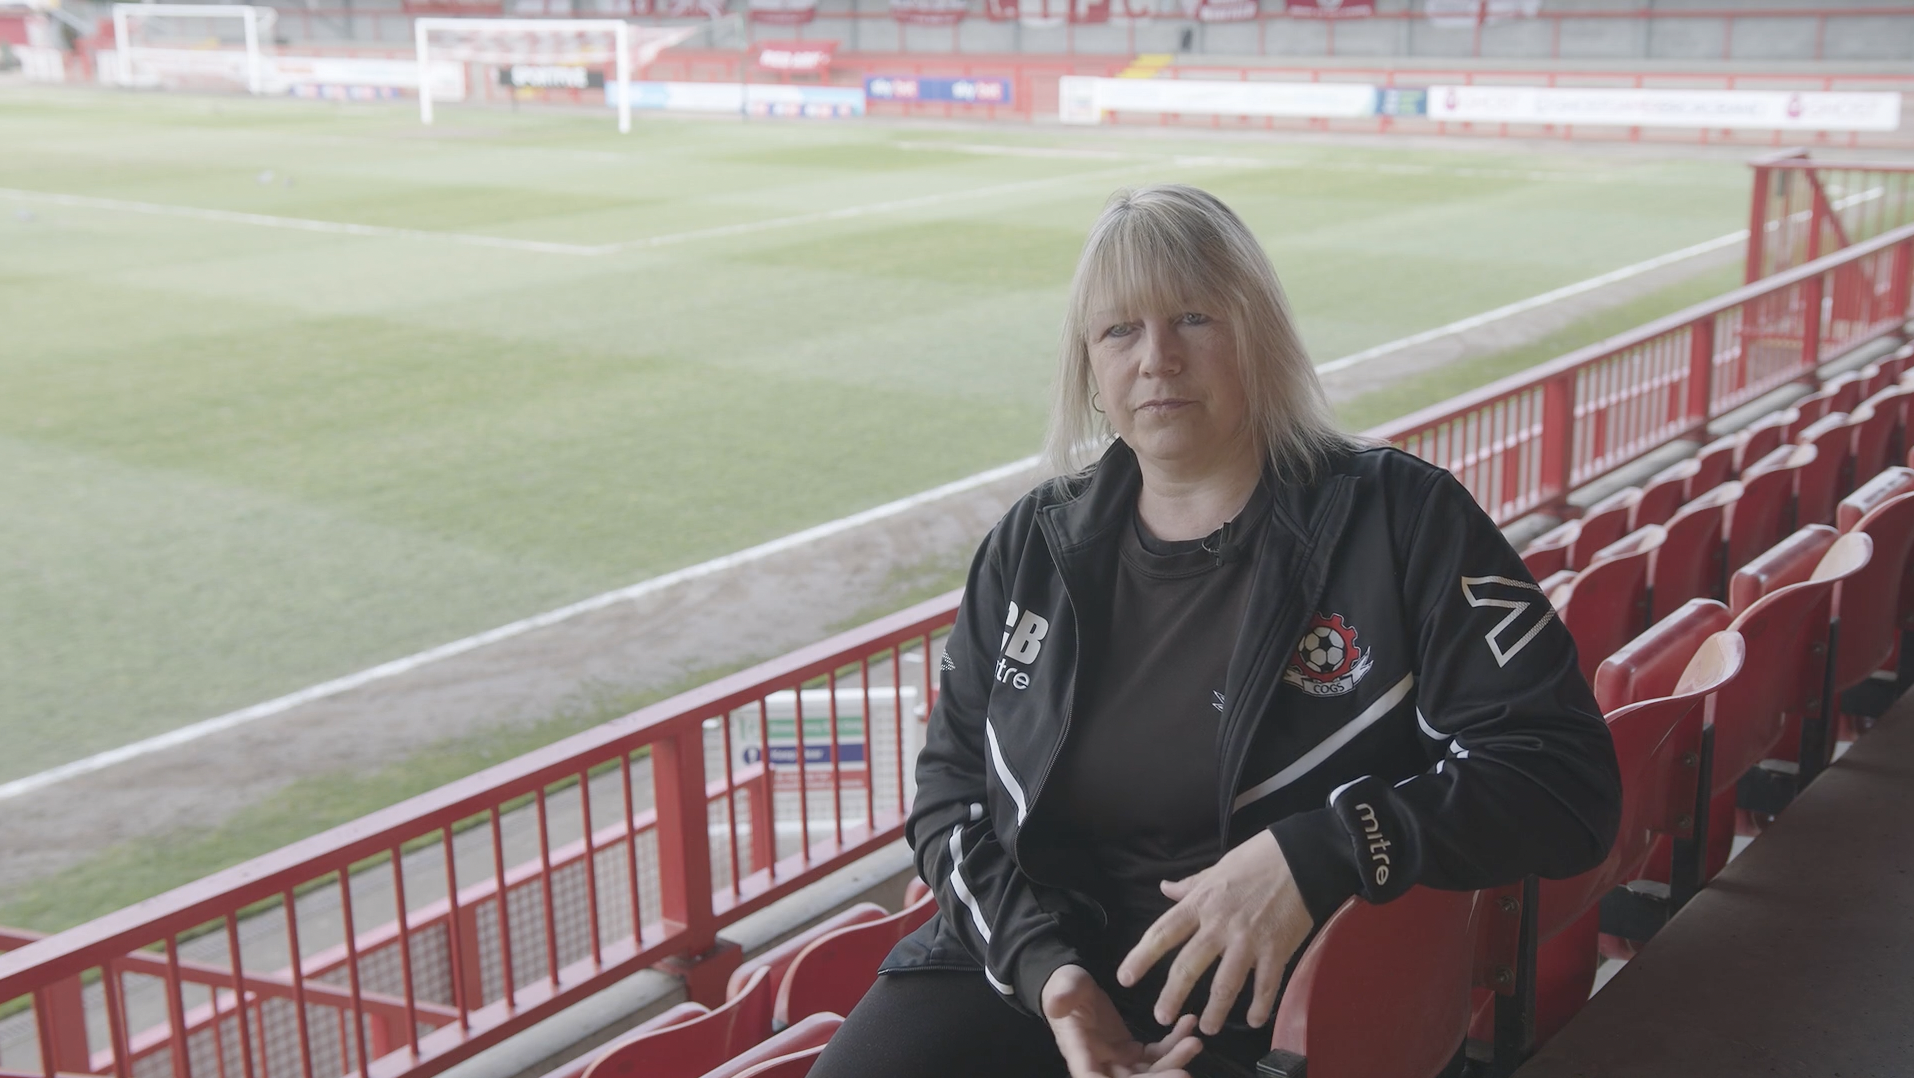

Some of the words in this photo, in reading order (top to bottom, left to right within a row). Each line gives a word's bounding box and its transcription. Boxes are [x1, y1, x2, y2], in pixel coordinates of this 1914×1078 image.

[995, 658, 1030, 690] tre
[1313, 683, 1345, 694] COGS
[1355, 803, 1391, 886] mitre
